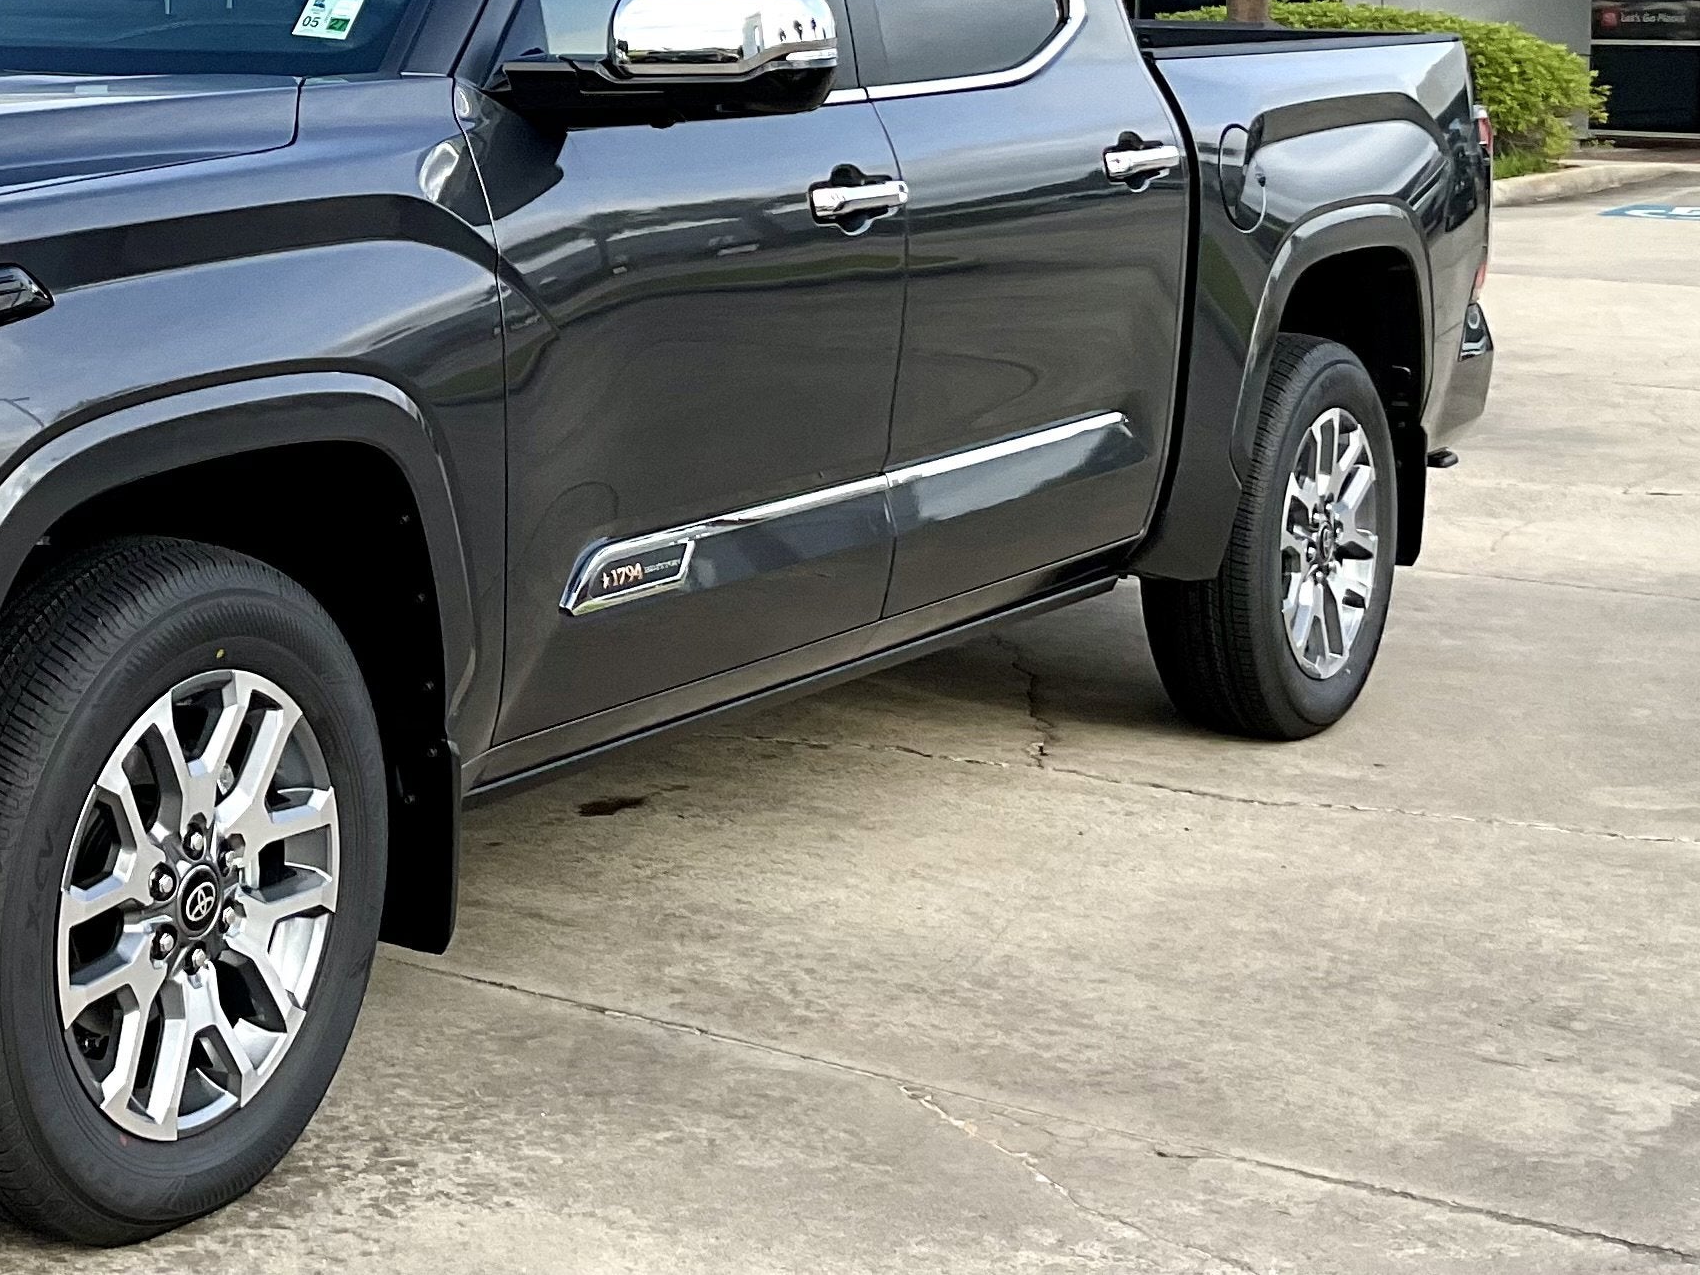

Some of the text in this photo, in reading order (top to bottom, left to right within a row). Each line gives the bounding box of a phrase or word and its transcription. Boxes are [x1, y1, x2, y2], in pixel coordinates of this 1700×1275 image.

[302, 16, 321, 28] 05
[329, 18, 348, 31] 27
[611, 563, 643, 586] 1794
